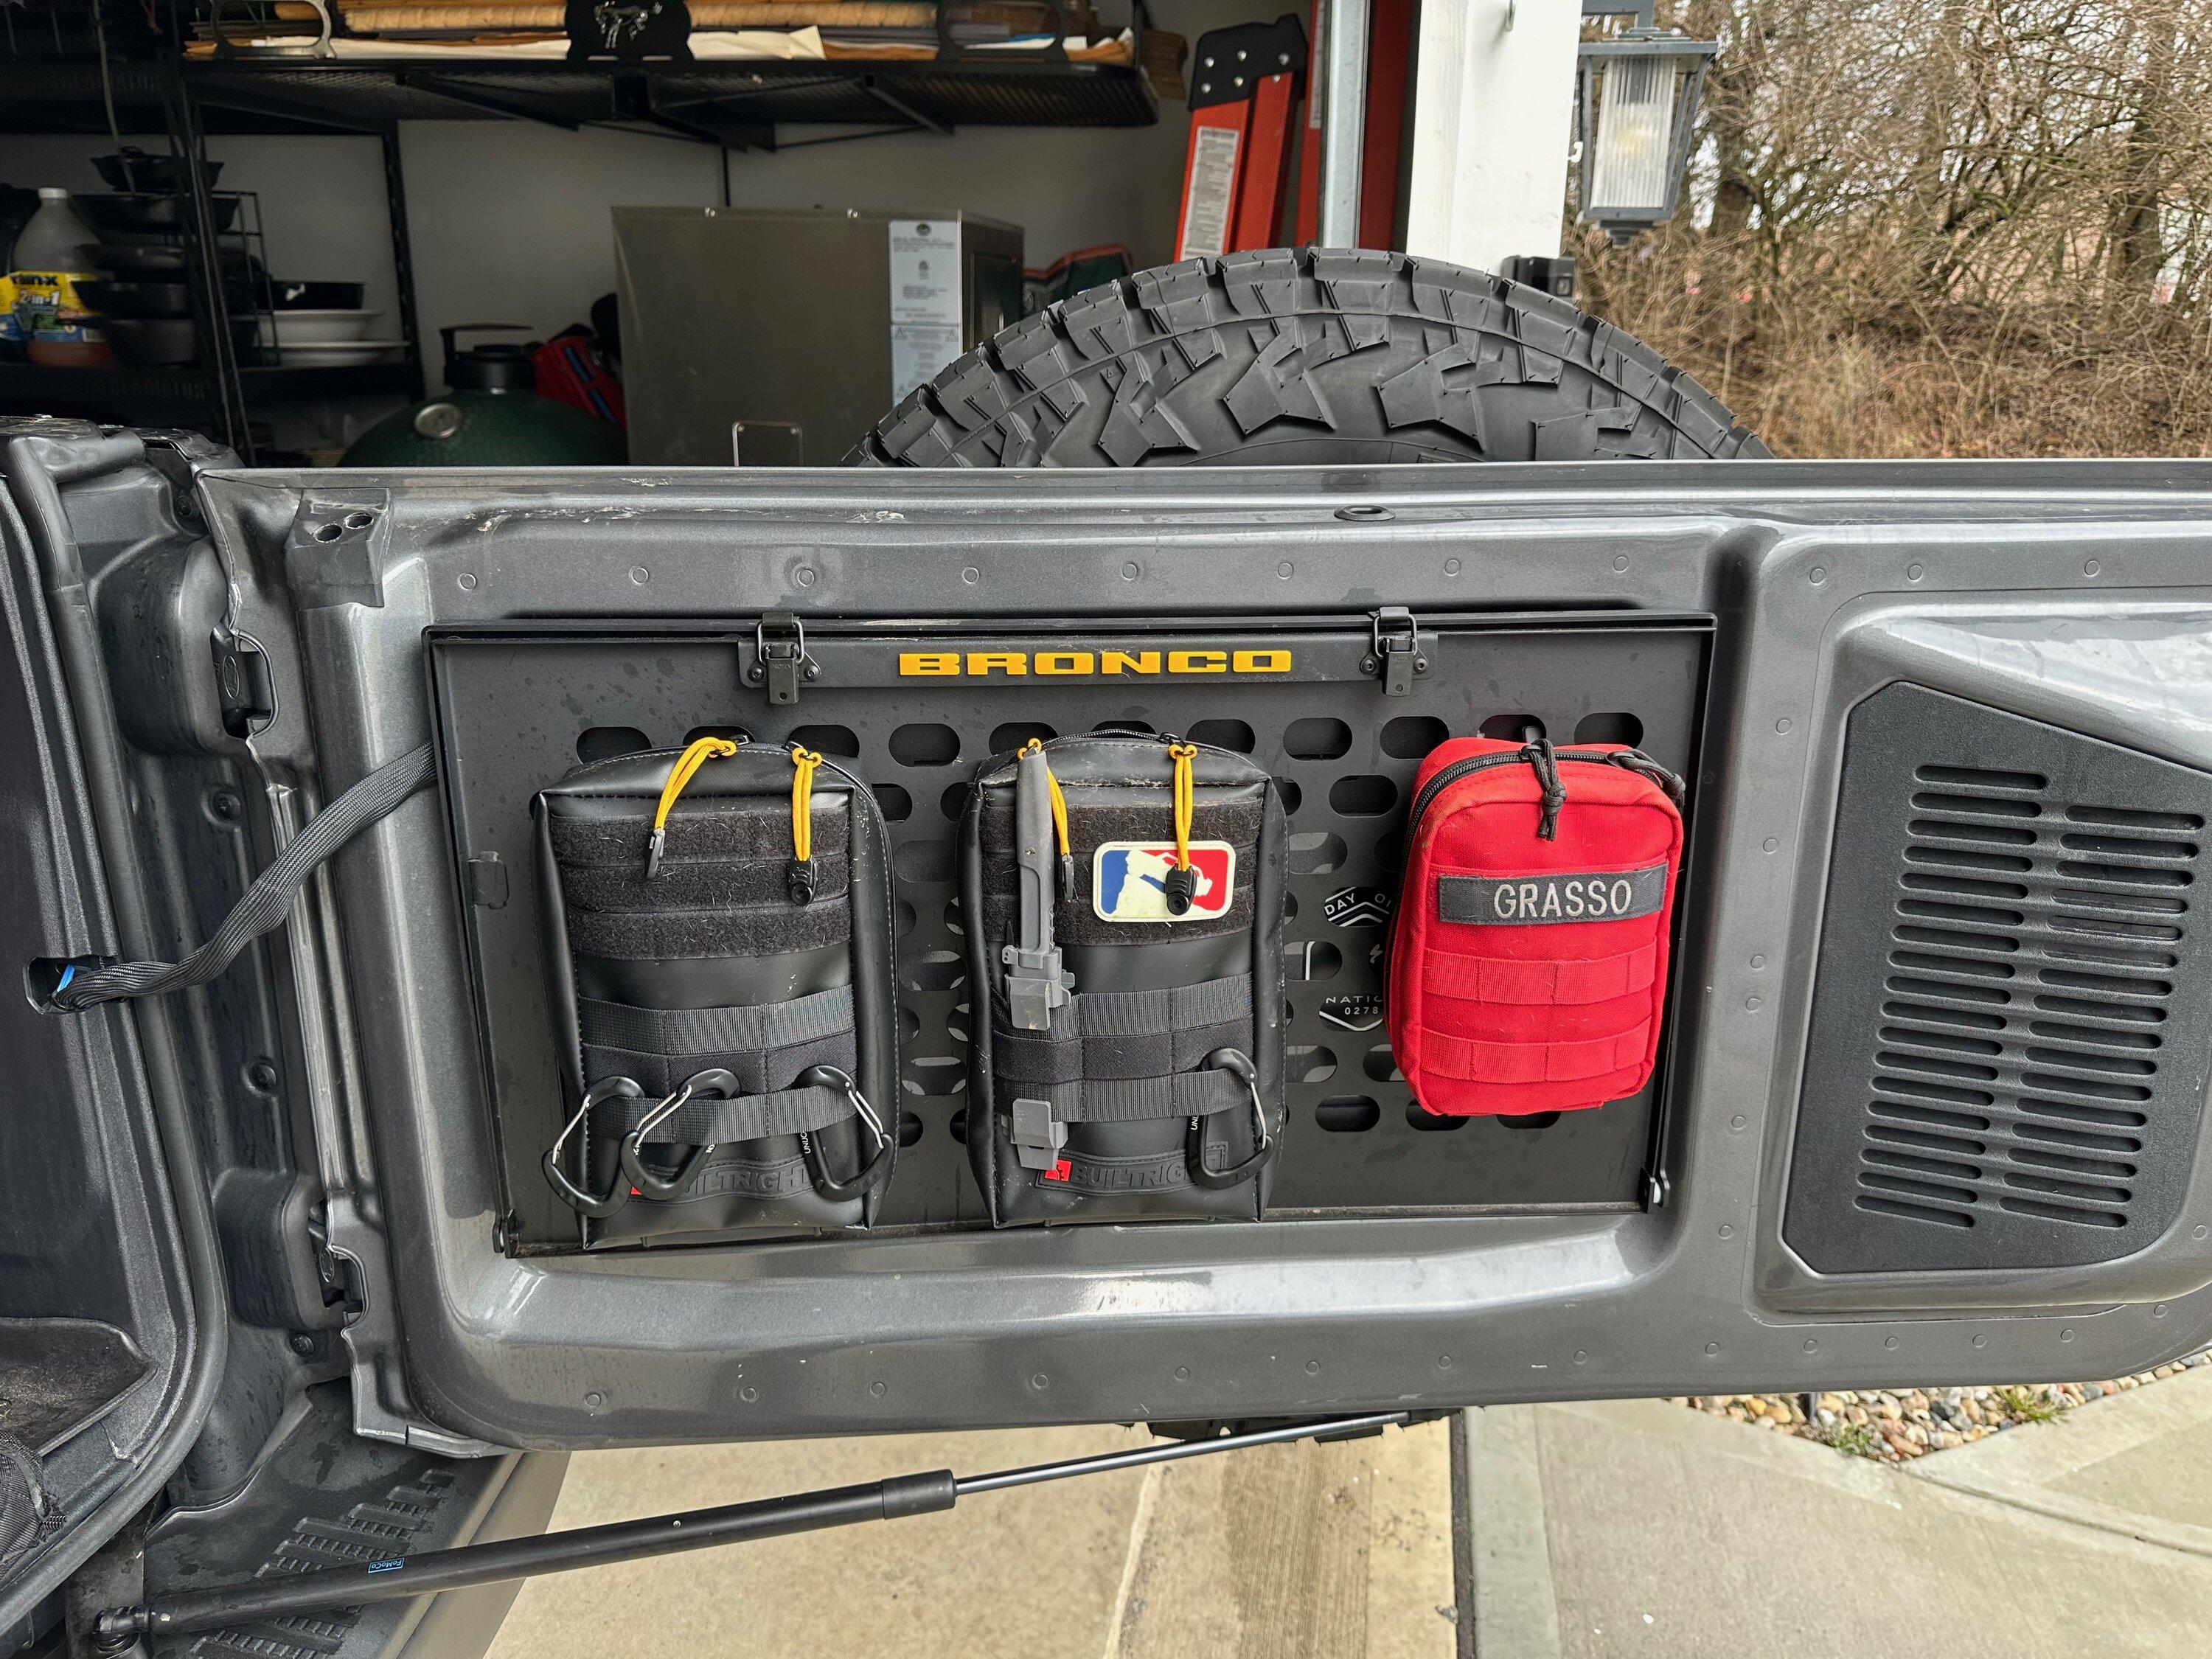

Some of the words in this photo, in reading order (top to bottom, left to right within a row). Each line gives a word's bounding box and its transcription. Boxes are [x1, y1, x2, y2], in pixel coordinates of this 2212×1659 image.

[899, 650, 1292, 675] BRONCO
[1324, 893, 1354, 916] DAY
[1494, 880, 1632, 919] GRASSO
[1344, 1006, 1378, 1015] 0278
[371, 1559, 403, 1569] FoMoCo
